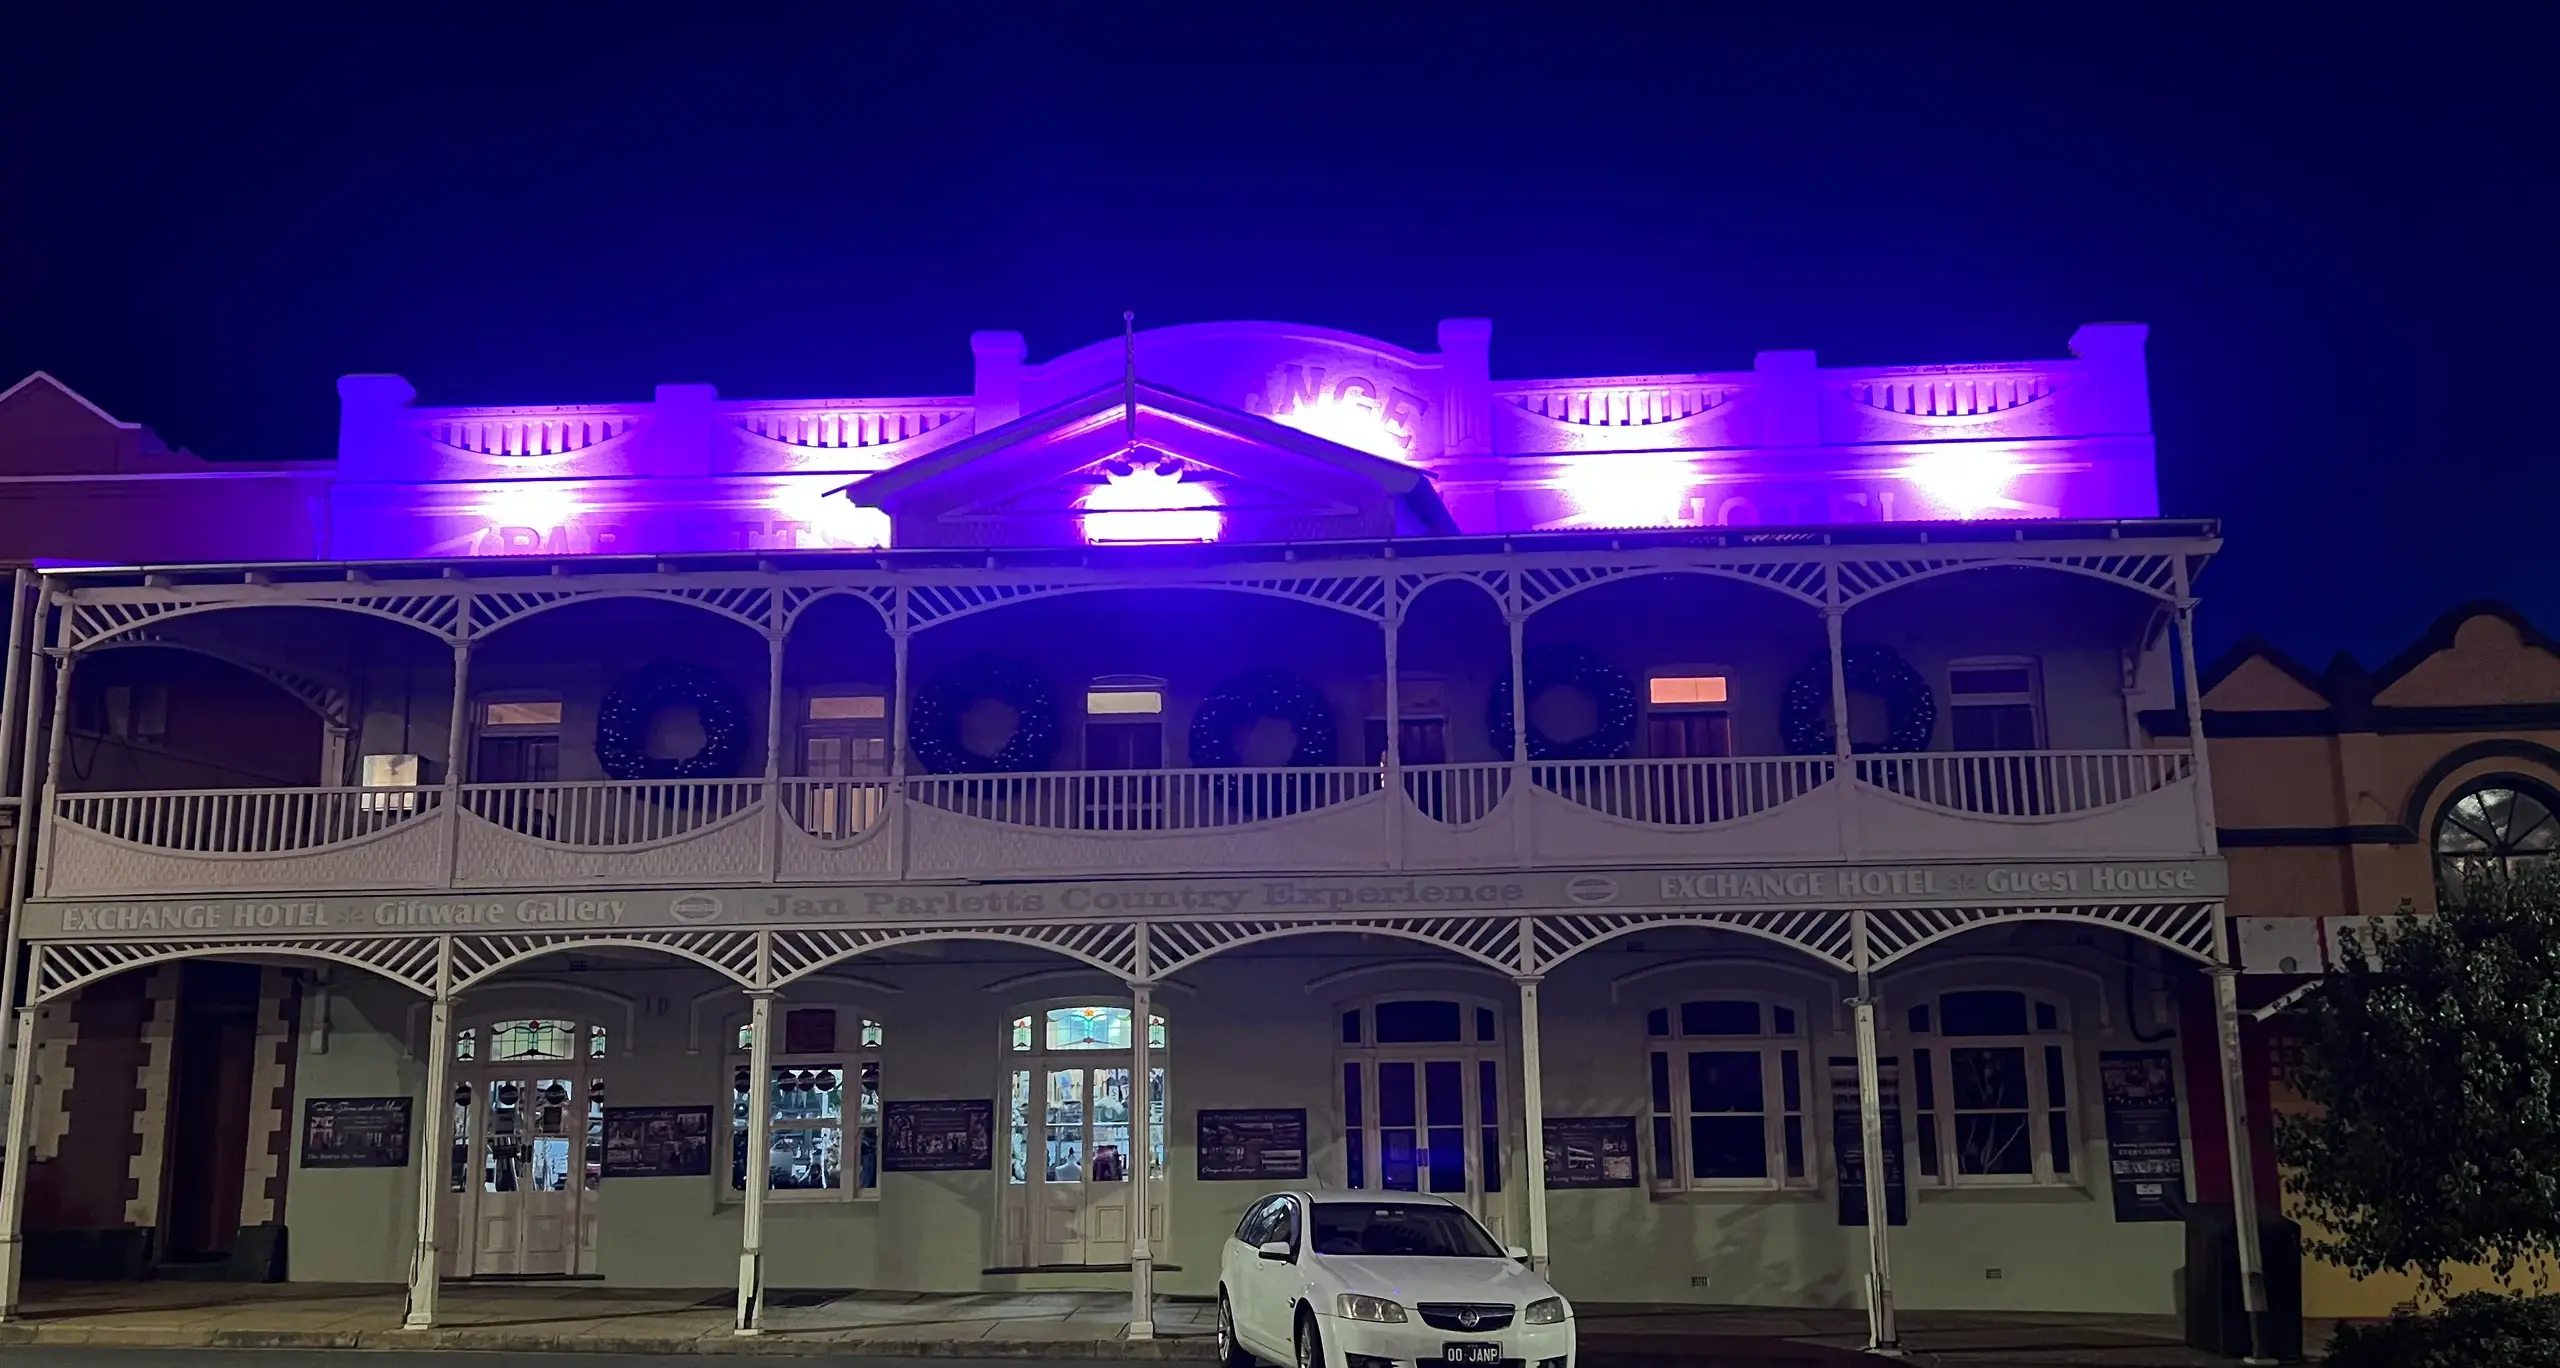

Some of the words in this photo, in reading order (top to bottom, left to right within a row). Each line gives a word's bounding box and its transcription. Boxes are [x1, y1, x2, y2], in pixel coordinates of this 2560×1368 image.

[764, 893, 848, 917] Jan
[863, 888, 1046, 916] Parletts
[1060, 885, 1252, 911] Country
[1261, 880, 1524, 910] Experience
[1660, 871, 1826, 900] EXCHANGE
[1838, 868, 1941, 897] HOTEL
[1986, 868, 2079, 893] Guest
[2091, 866, 2196, 892] House
[61, 905, 222, 931] EXCHANGE
[233, 901, 330, 928] HOTEL
[375, 898, 505, 926] Giftware
[516, 895, 628, 925] Gallery
[1468, 1348, 1498, 1362] JANP
